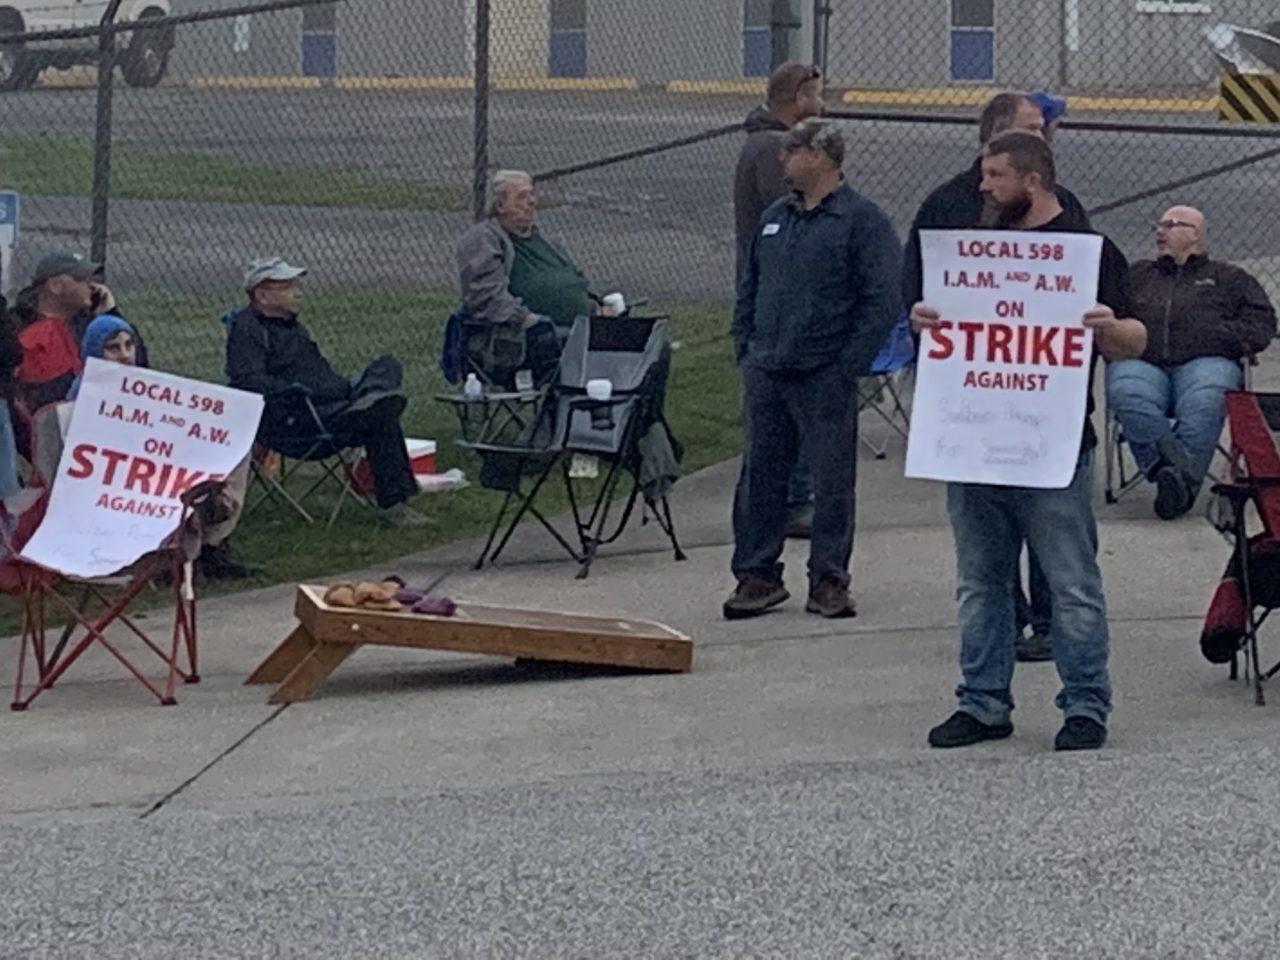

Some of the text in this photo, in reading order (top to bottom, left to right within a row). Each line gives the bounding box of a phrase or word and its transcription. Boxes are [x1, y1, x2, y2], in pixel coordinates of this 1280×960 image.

[957, 240, 1064, 261] LOCAL 598
[944, 271, 1076, 293] I.A.M. AND A.W.
[996, 300, 1024, 318] ON
[927, 321, 1086, 368] STRIKE
[963, 371, 1049, 391] AGAINST
[120, 377, 225, 416] LOCAL 598
[98, 399, 231, 447] I.A.M. AND A.W.
[144, 438, 174, 458] ON
[95, 492, 180, 520] AGAINST
